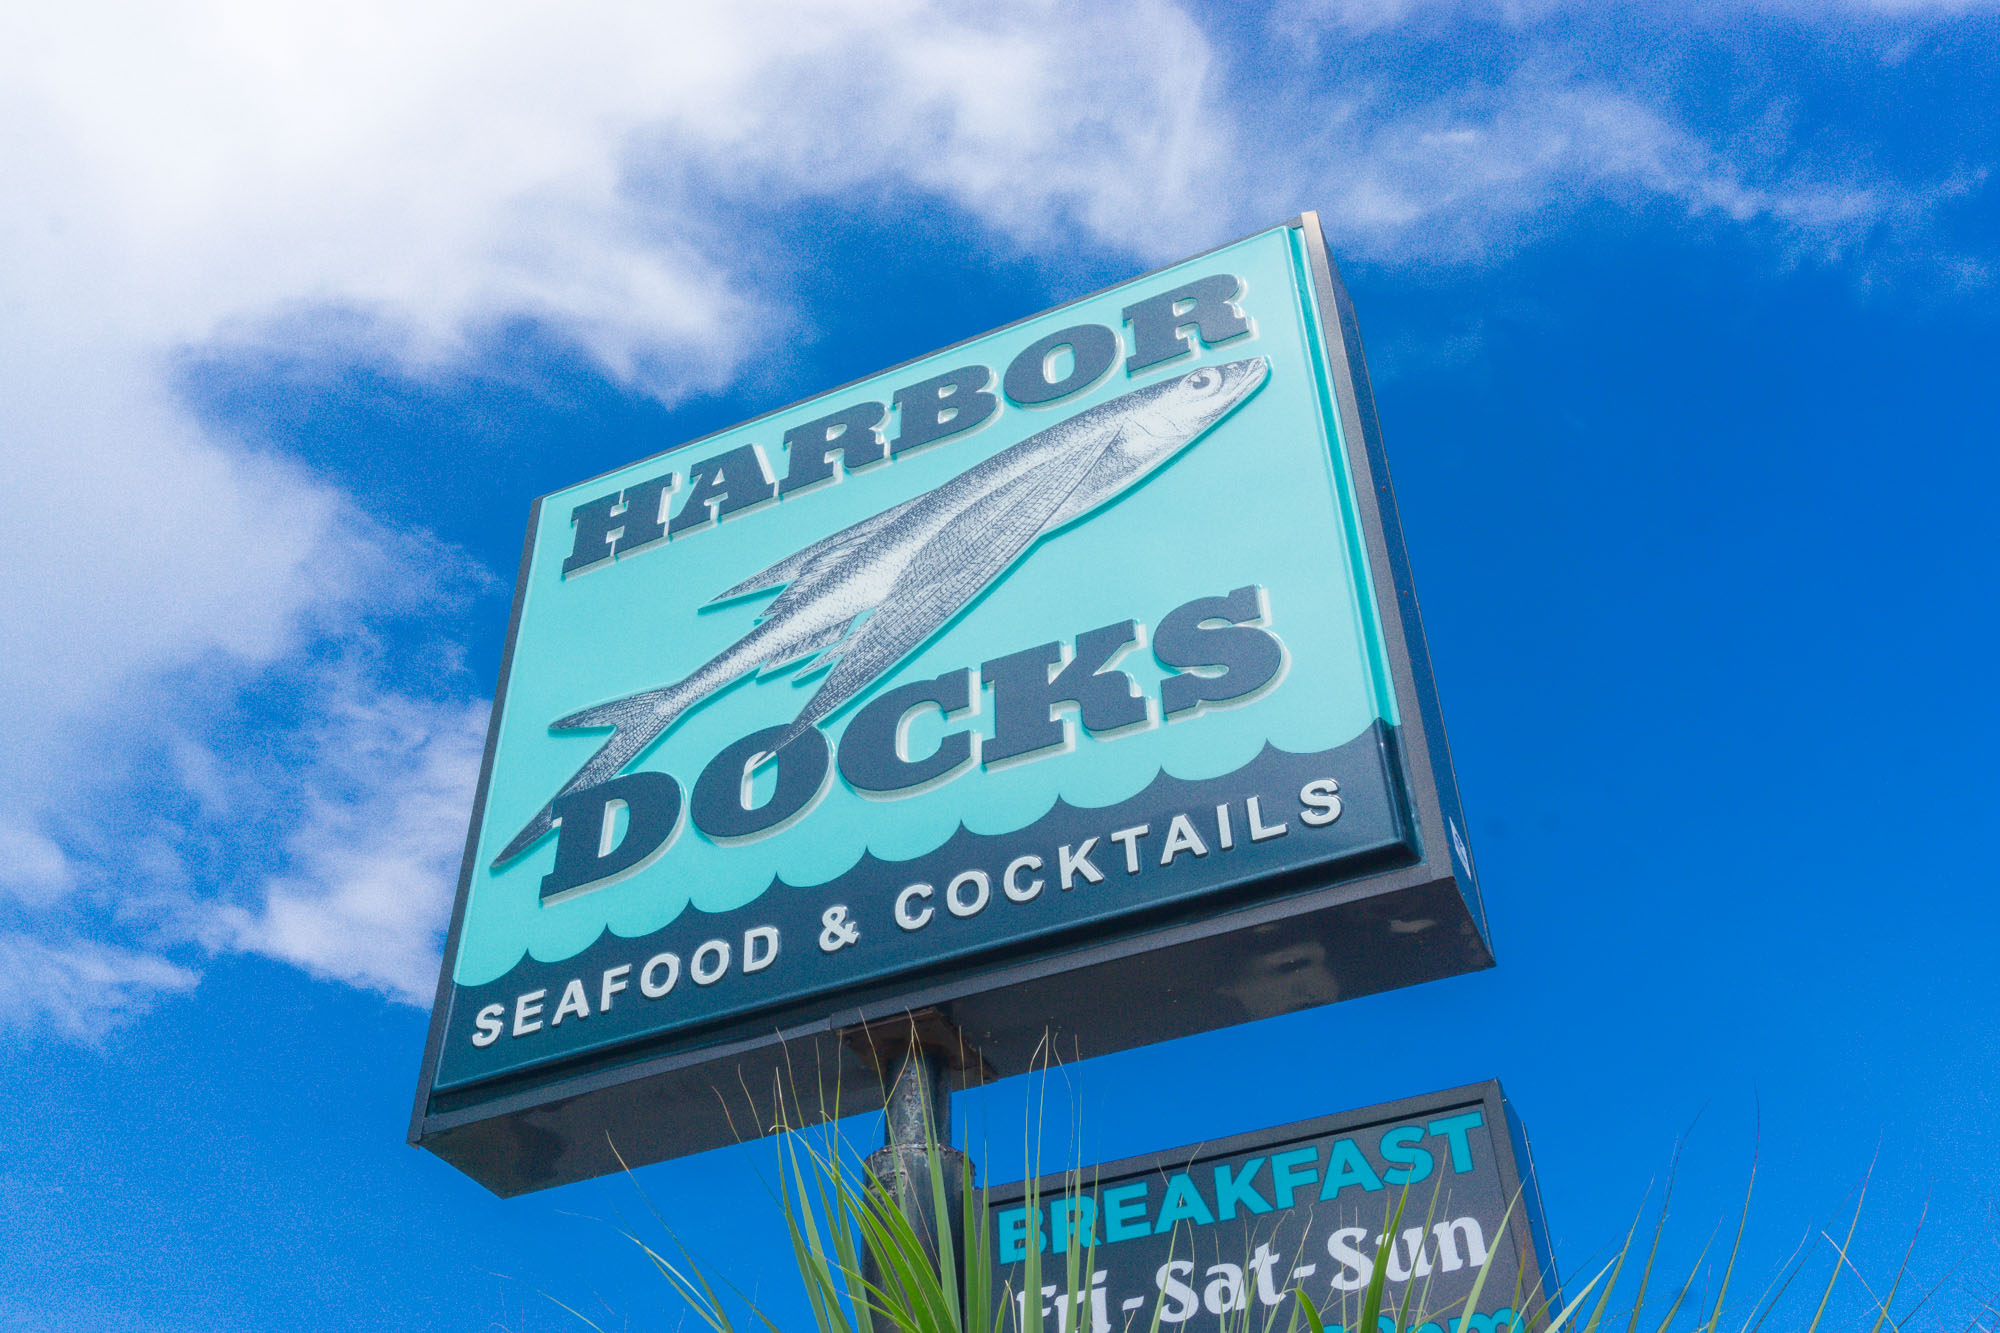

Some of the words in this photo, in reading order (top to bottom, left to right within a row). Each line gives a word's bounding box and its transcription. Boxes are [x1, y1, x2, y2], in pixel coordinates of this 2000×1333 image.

[562, 272, 1256, 578] HARBOR
[539, 584, 1291, 908] DOCKS
[470, 925, 780, 1049] SEAFOOD
[818, 903, 860, 953] &
[894, 777, 1345, 931] COCKTAILS
[998, 1110, 1484, 1265] BREAKFAST
